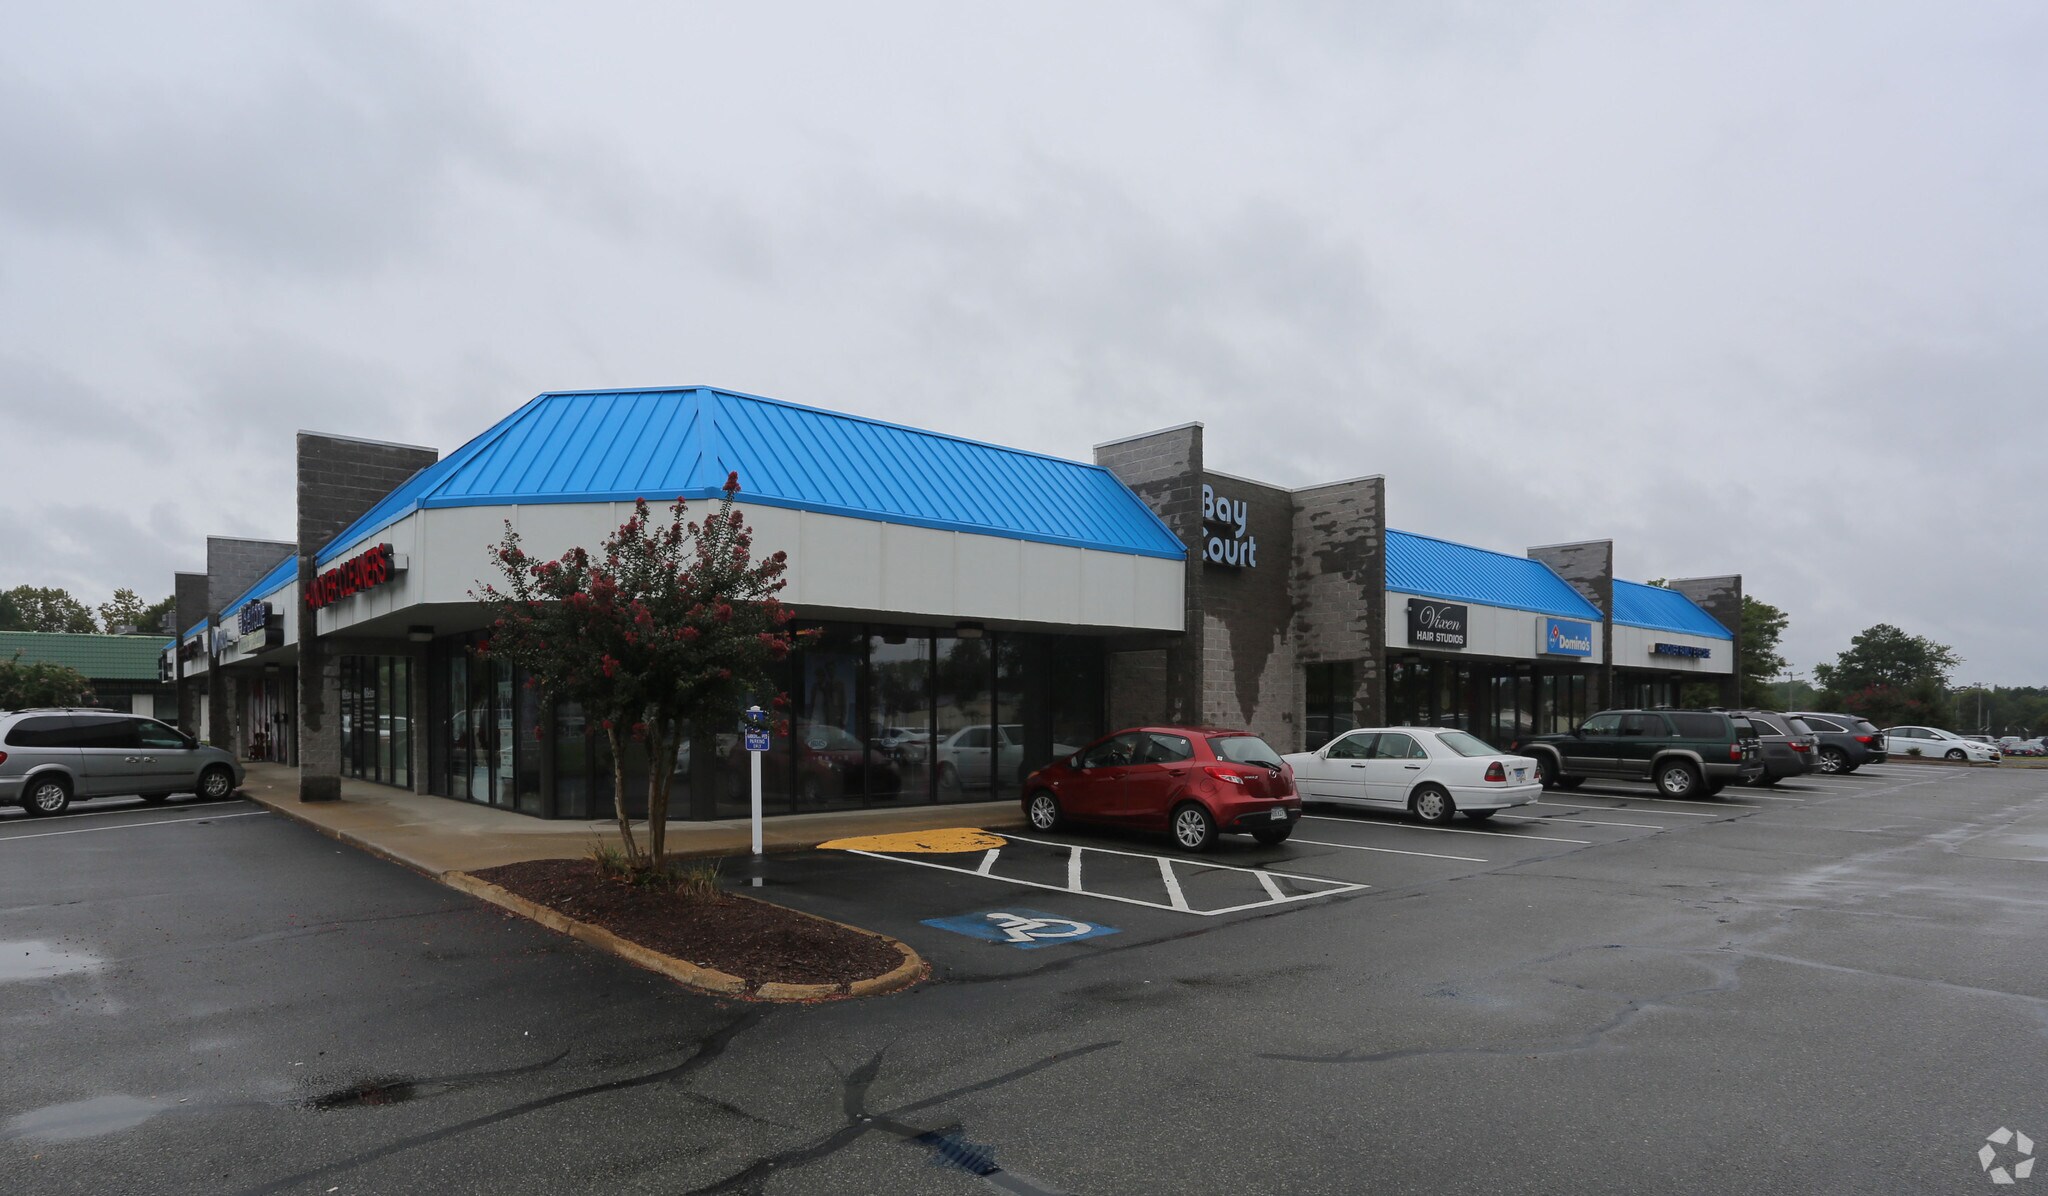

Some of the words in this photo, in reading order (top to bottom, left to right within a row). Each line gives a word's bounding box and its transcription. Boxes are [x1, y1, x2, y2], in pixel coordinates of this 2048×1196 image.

[1202, 483, 1247, 538] Bay
[1202, 526, 1257, 568] ourt
[1419, 605, 1461, 631] Vixen
[1416, 630, 1434, 642] HAIR
[1436, 632, 1464, 645] STUDIOS
[1559, 634, 1591, 652] Domino's
